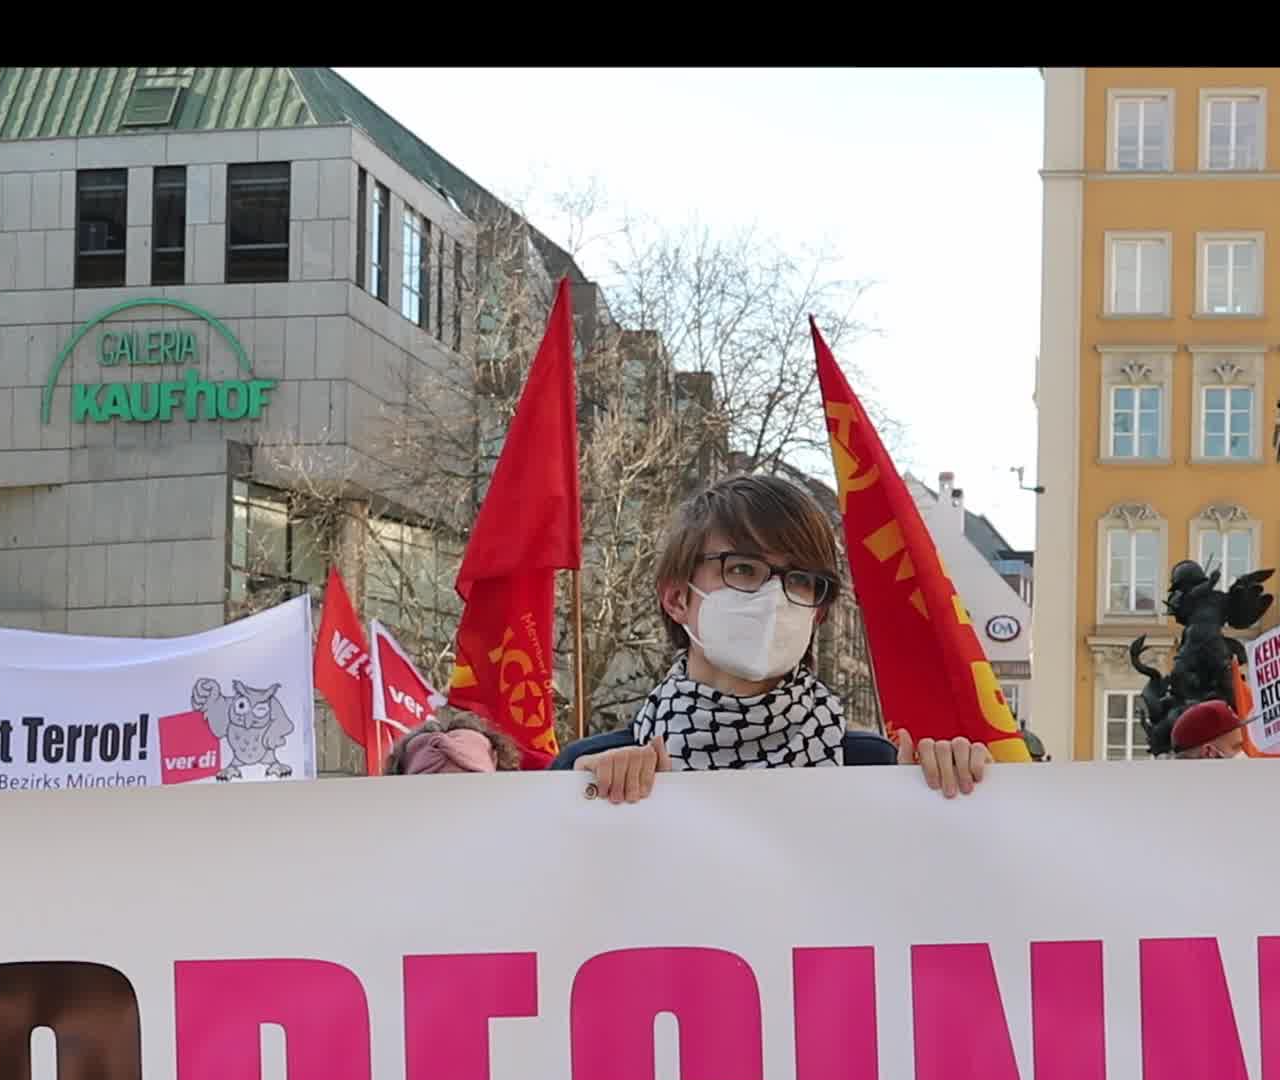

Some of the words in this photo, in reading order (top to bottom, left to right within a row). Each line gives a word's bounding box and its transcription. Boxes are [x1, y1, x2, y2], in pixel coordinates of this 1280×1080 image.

[97, 328, 199, 366] GALERIA
[22, 714, 149, 763] Terror!
[0, 773, 60, 790] Bezirks
[67, 771, 148, 788] München
